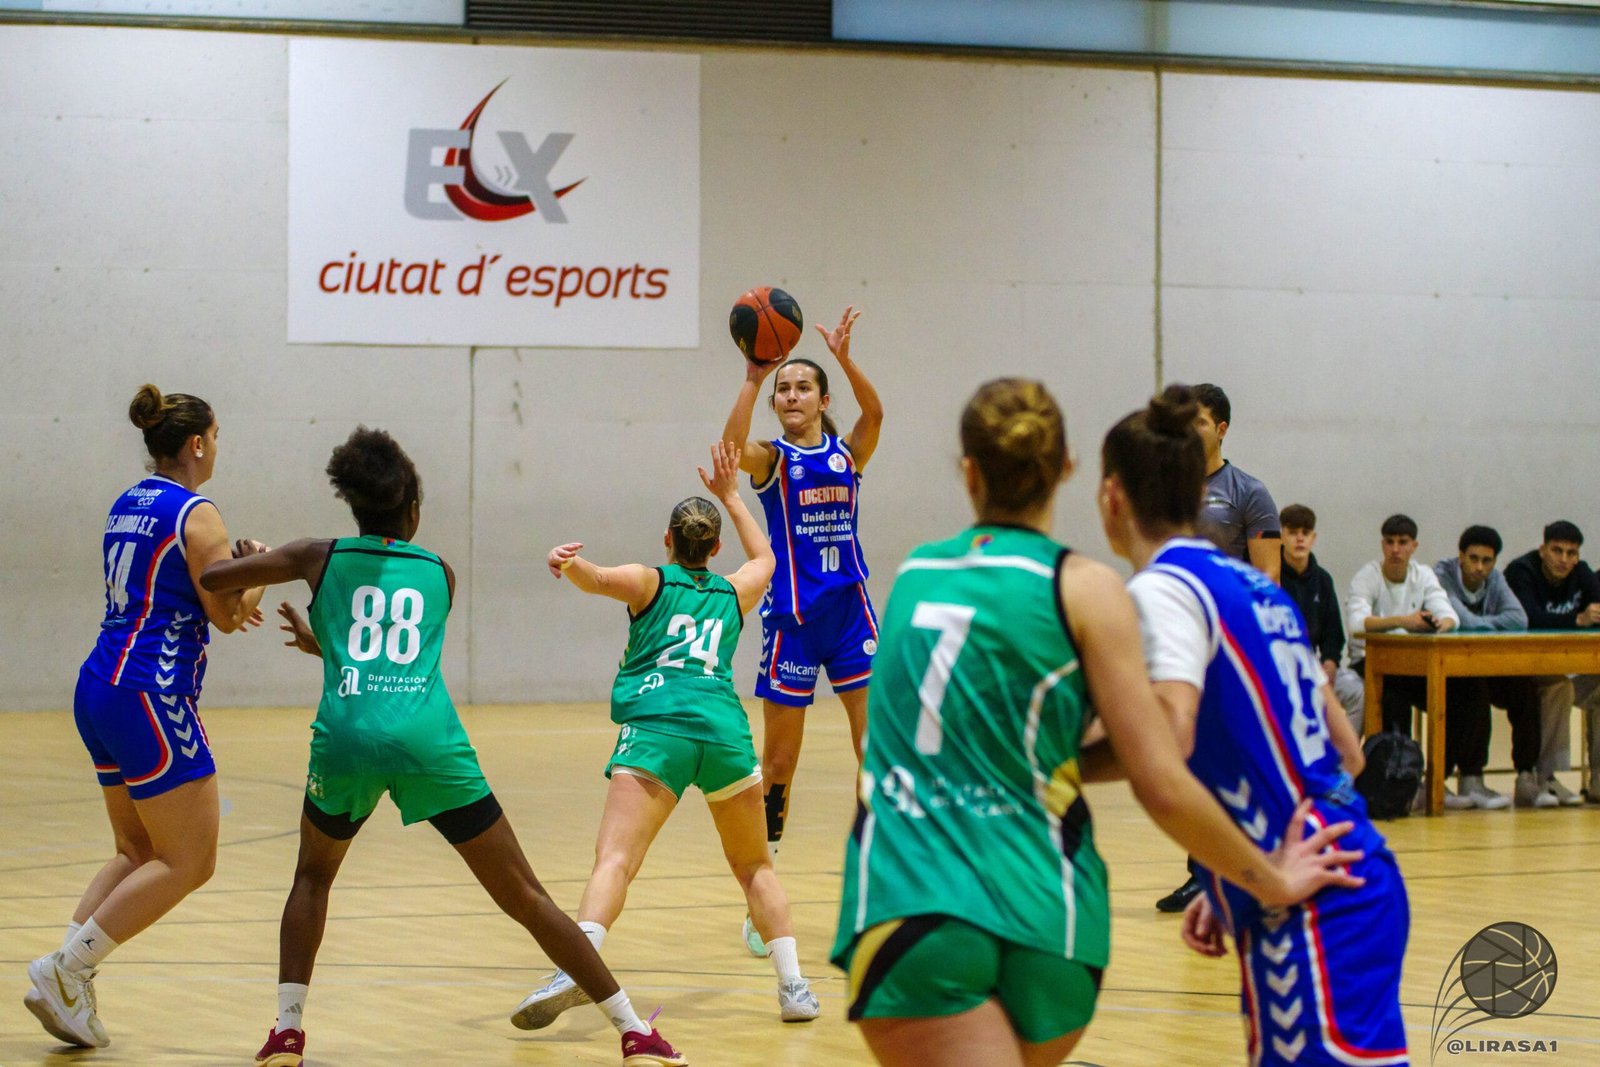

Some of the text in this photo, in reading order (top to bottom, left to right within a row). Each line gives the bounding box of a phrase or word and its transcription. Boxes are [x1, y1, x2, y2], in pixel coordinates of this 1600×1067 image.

[318, 251, 446, 296] ciutat
[505, 263, 670, 307] esports
[137, 497, 155, 506] eco
[799, 486, 849, 506] LUCENTUM
[802, 509, 850, 523] Unidad de
[106, 541, 137, 615] 14
[820, 546, 840, 573] 10
[347, 585, 425, 665] 88
[656, 614, 724, 676] 24
[367, 683, 379, 692] DE
[911, 601, 977, 756] 7
